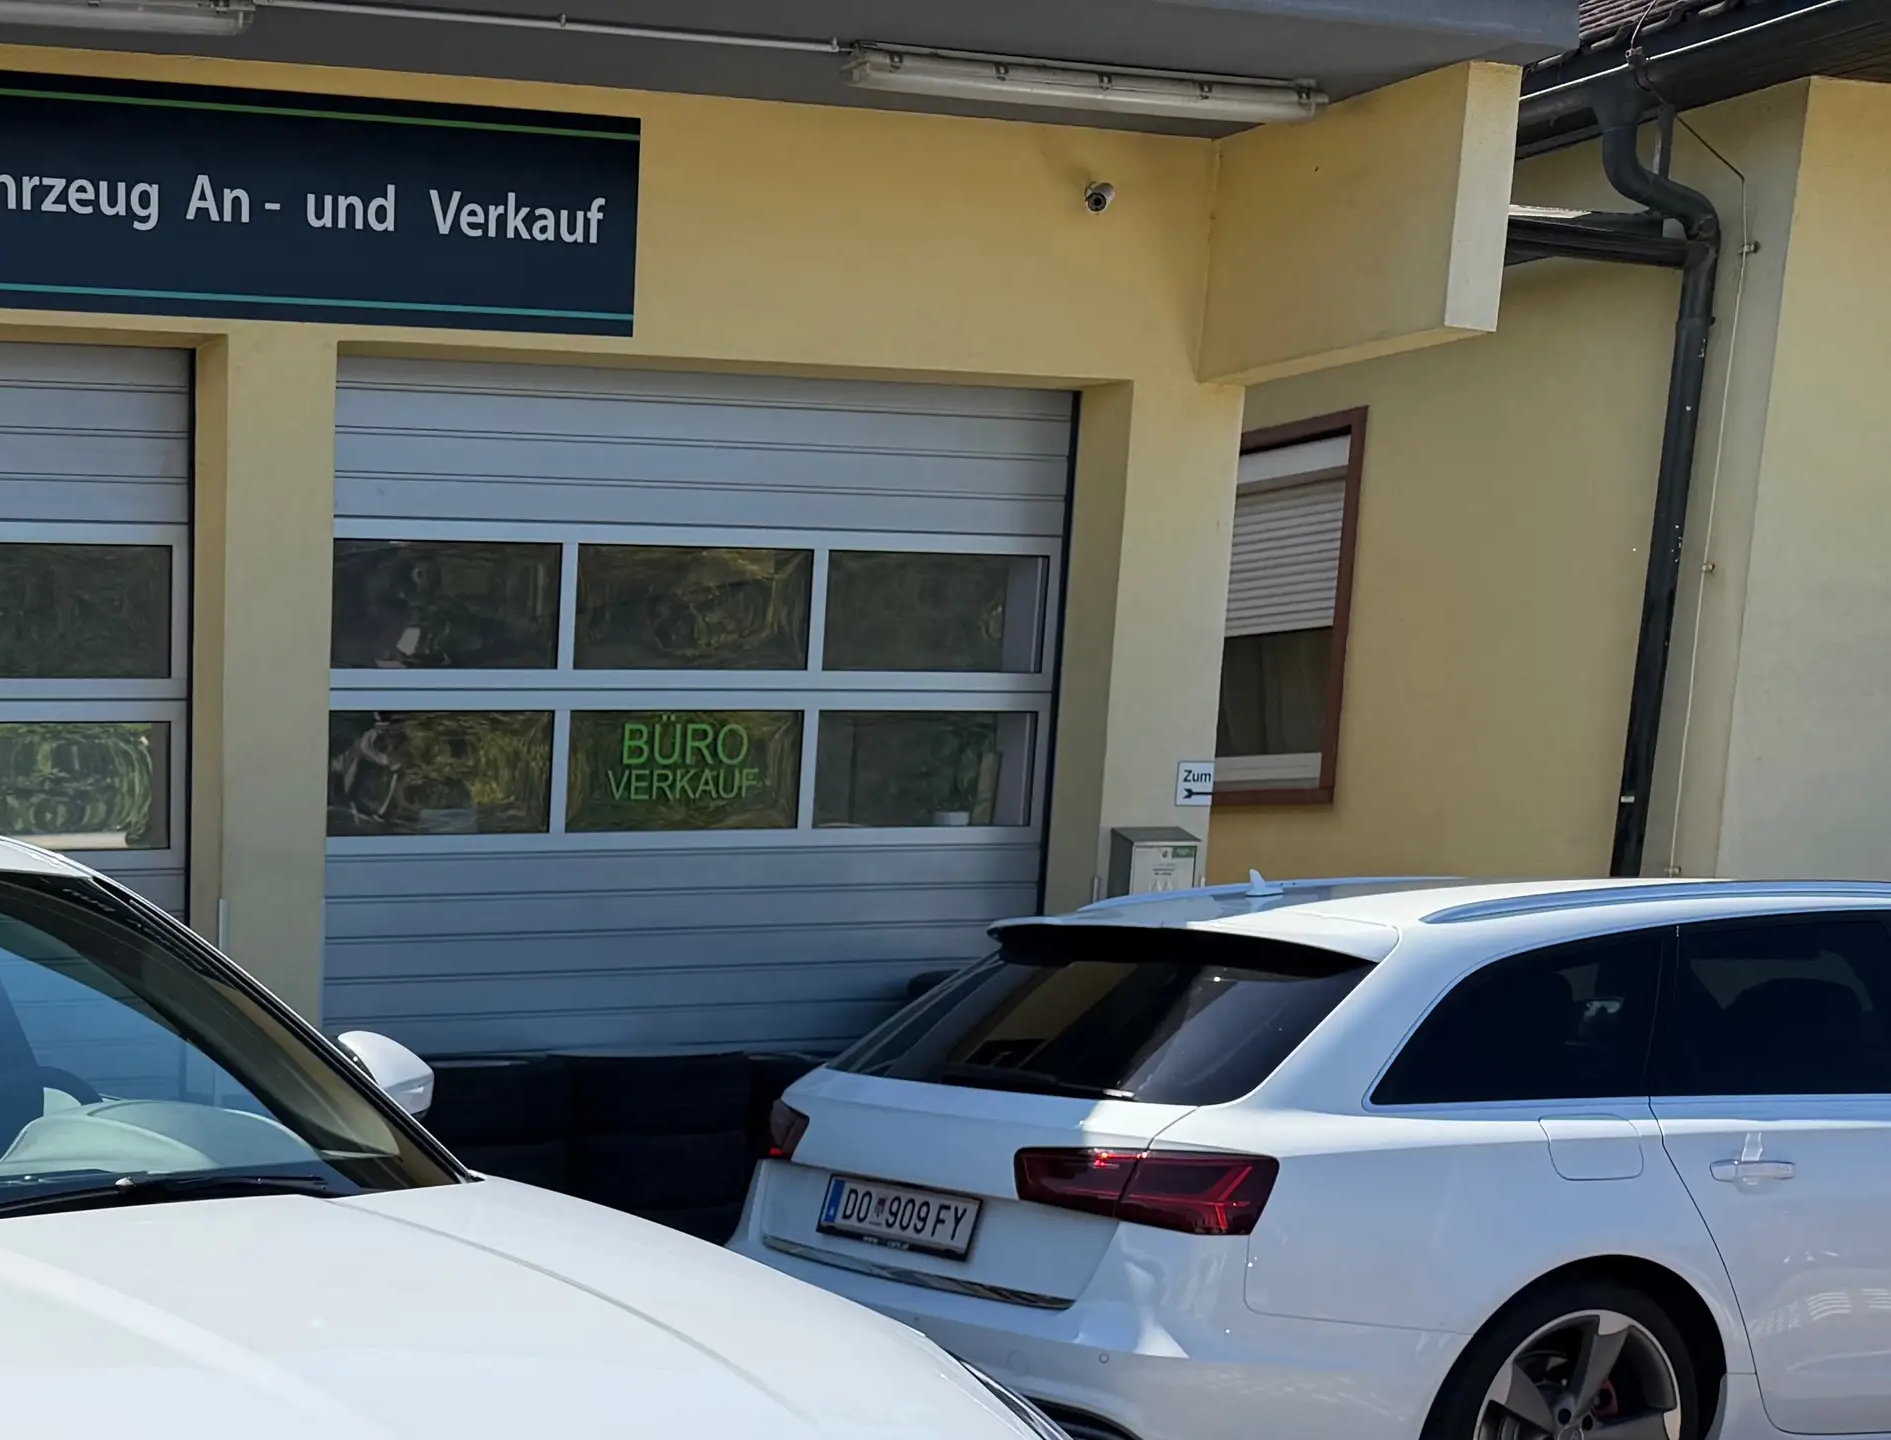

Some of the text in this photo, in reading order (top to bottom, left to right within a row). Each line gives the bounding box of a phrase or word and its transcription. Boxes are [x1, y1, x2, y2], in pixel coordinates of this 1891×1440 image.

[305, 185, 397, 232] und
[429, 190, 606, 245] Verkauf
[622, 714, 749, 766] BÜRO
[608, 768, 760, 800] VERKAUF
[1183, 769, 1212, 783] Zum
[842, 1188, 873, 1223] DO
[885, 1195, 931, 1234] 909
[930, 1203, 968, 1241] FY
